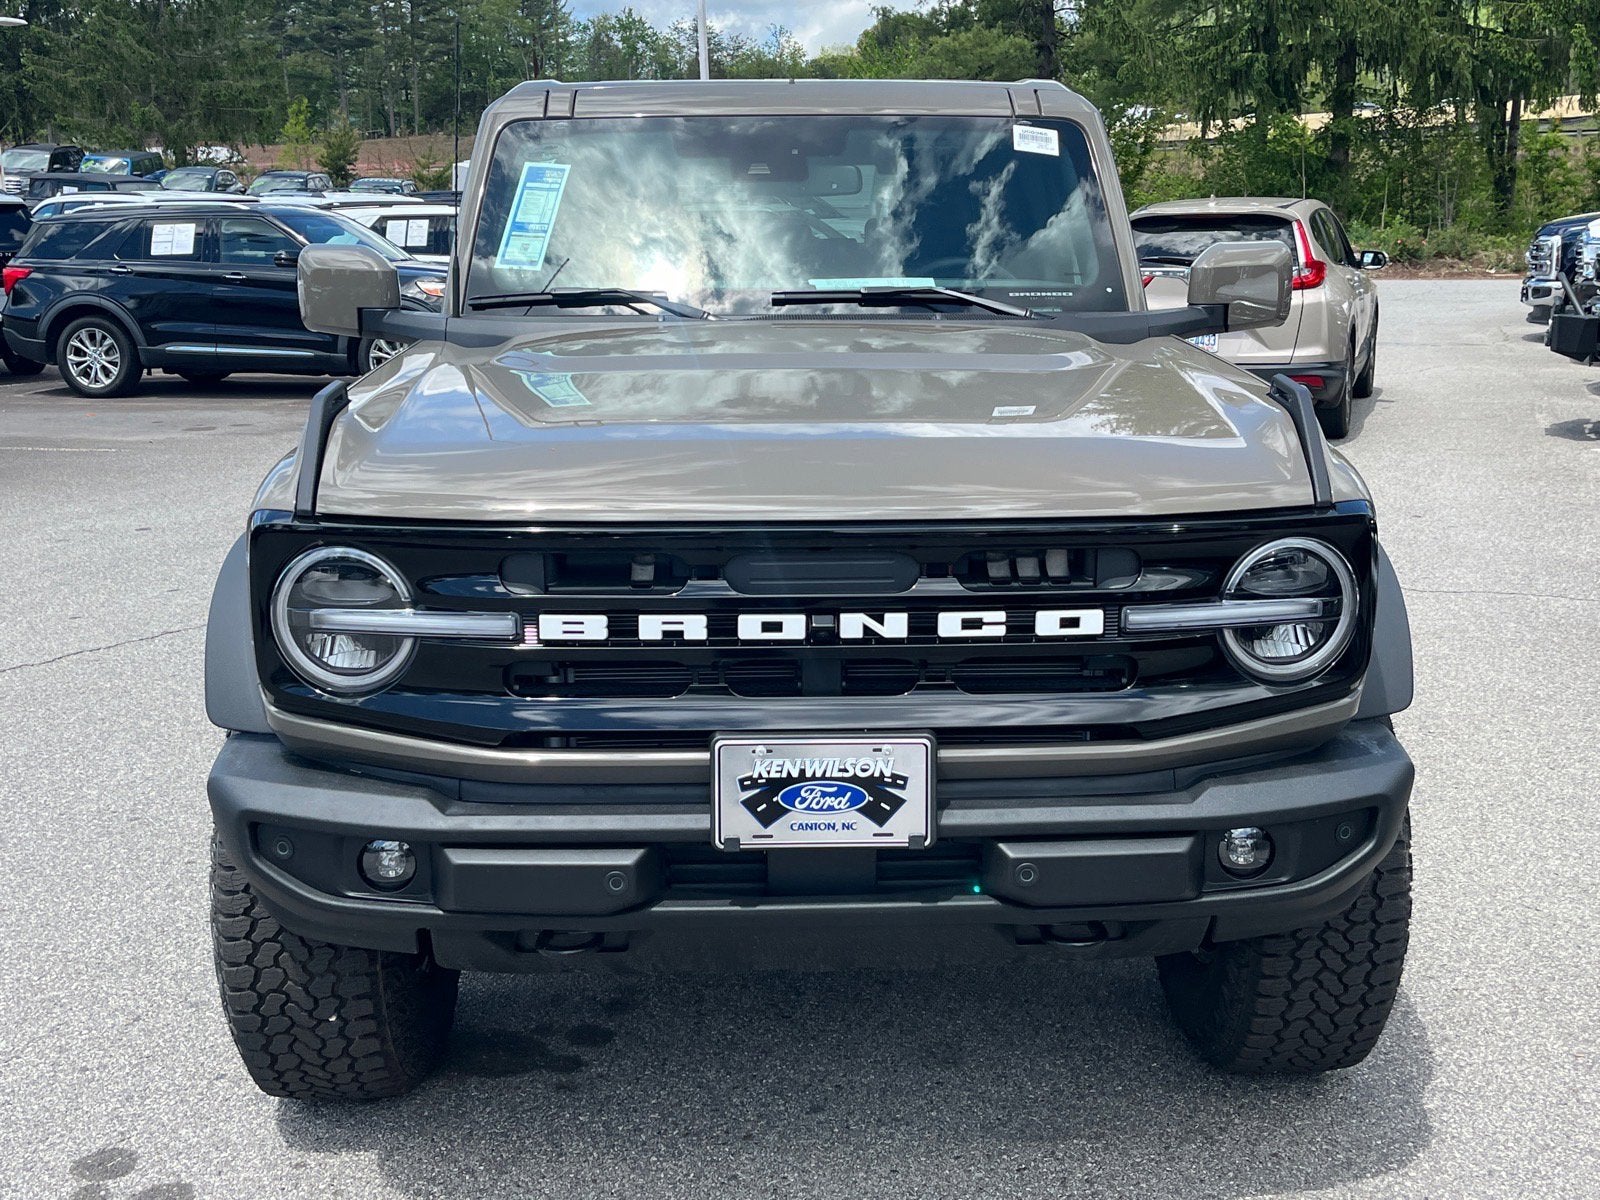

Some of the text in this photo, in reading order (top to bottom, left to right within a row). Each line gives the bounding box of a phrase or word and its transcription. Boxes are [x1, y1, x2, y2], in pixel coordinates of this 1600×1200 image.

[538, 609, 1104, 640] BRONCO
[752, 757, 895, 778] KEN WILSON
[794, 785, 852, 810] Ford
[790, 820, 857, 833] CANTON, NC
